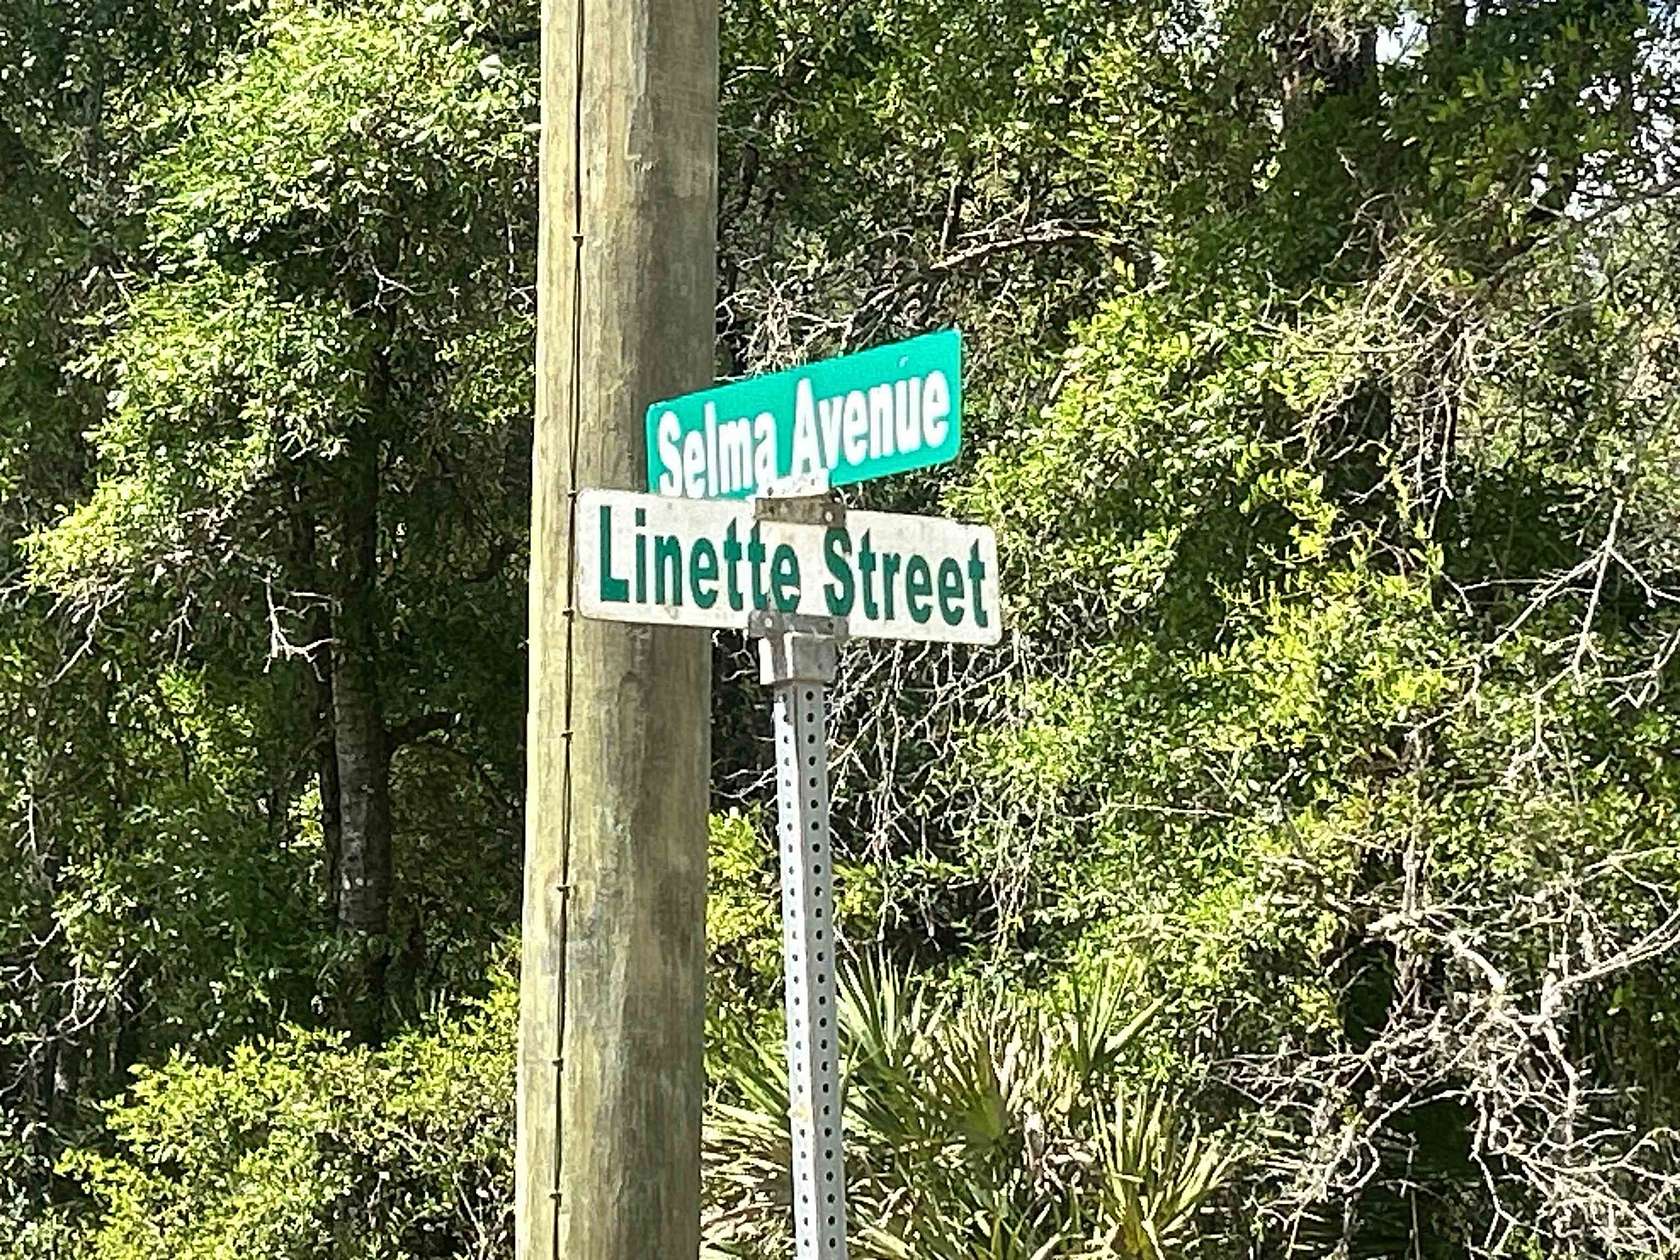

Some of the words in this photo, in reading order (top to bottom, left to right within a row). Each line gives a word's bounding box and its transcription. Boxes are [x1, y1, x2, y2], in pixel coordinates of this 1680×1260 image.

[658, 400, 778, 498] Selma
[790, 369, 951, 478] Avenue
[599, 505, 799, 613] Linette
[823, 525, 988, 628] Street
